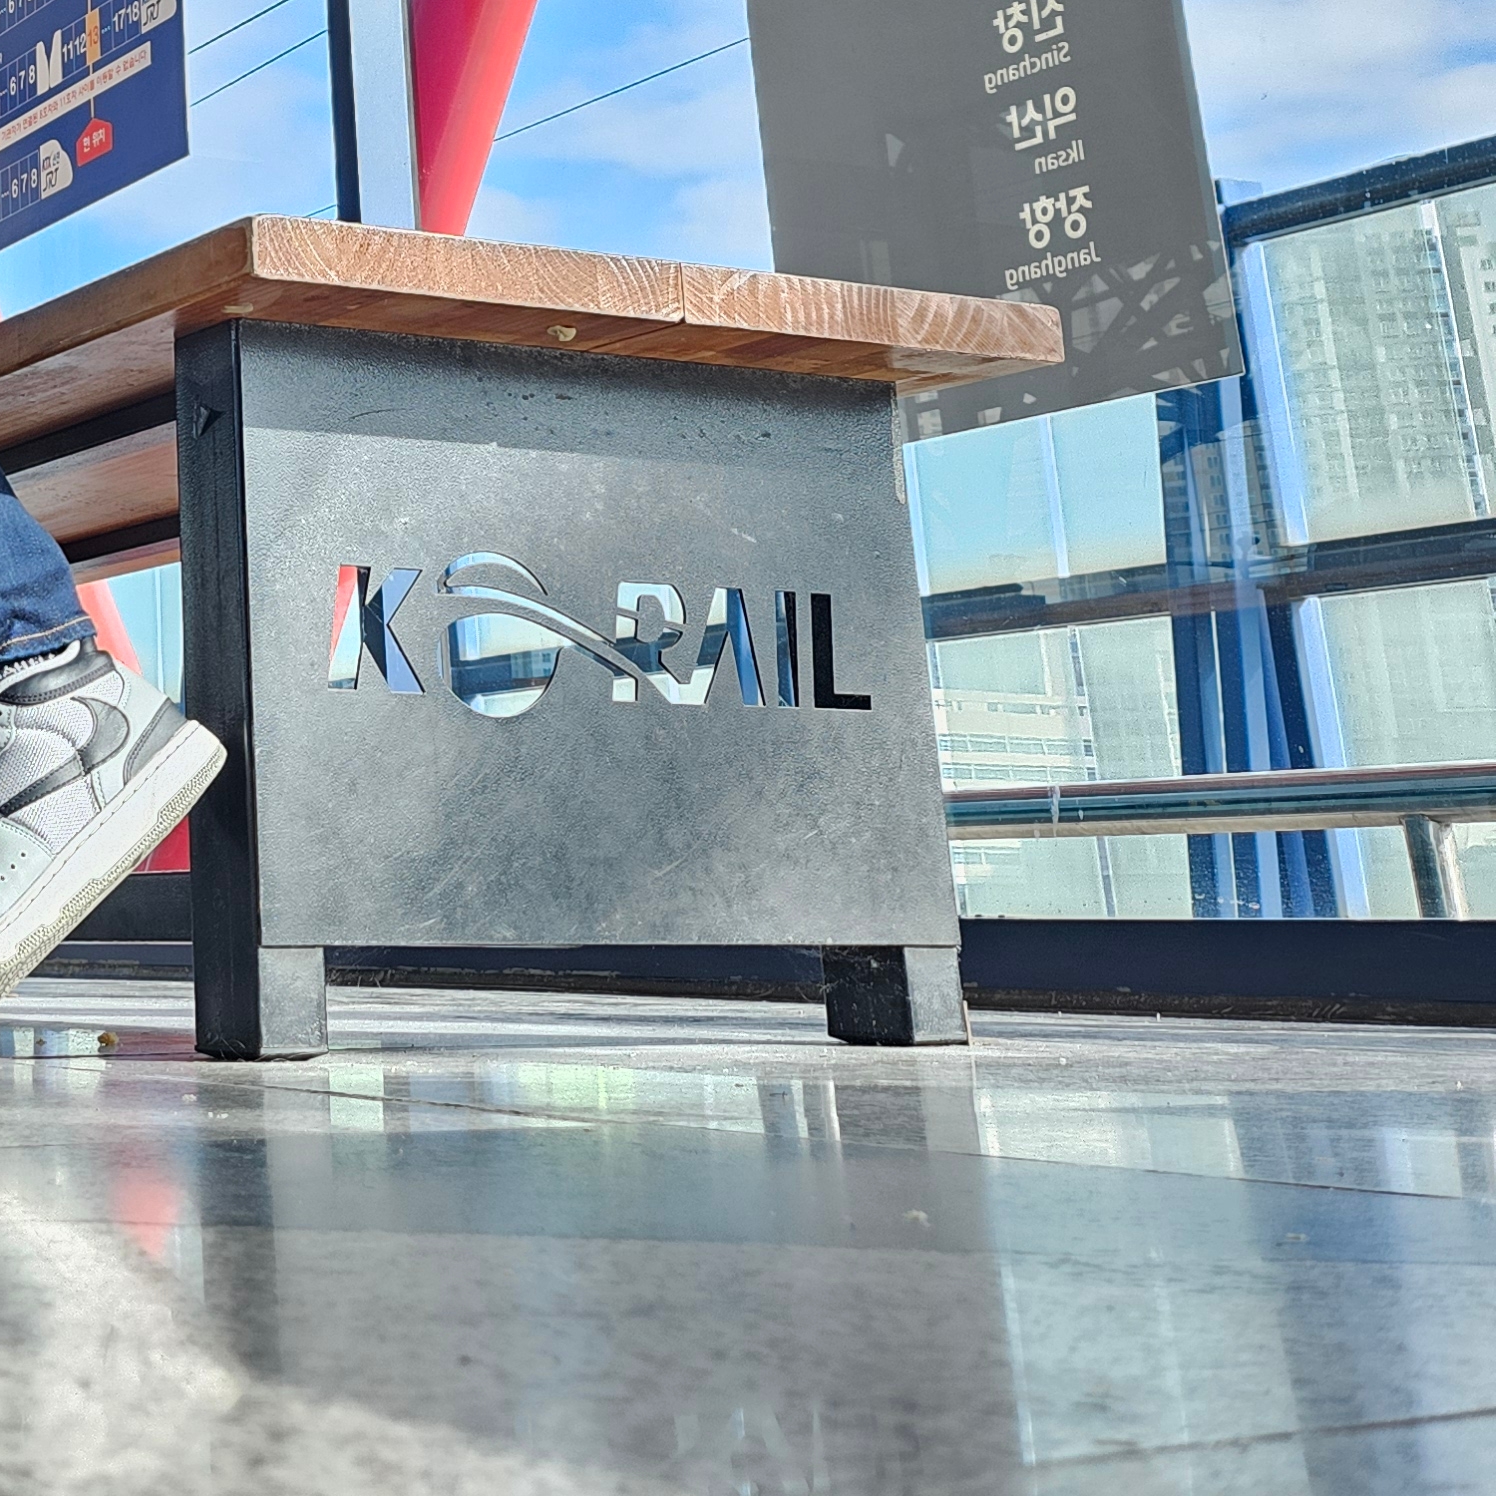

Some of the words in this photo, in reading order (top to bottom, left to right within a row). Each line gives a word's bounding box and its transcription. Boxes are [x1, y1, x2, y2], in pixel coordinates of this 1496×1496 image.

[9, 76, 16, 96] 6
[19, 70, 26, 89] 7
[29, 65, 35, 84] 8
[62, 40, 74, 63] 11
[74, 33, 86, 55] 12
[88, 26, 99, 47] 13
[112, 8, 125, 32] 17
[126, 1, 139, 24] 18
[11, 178, 18, 198] 6
[21, 173, 28, 193] 7
[31, 168, 37, 188] 8
[327, 551, 873, 719] KORAIL
